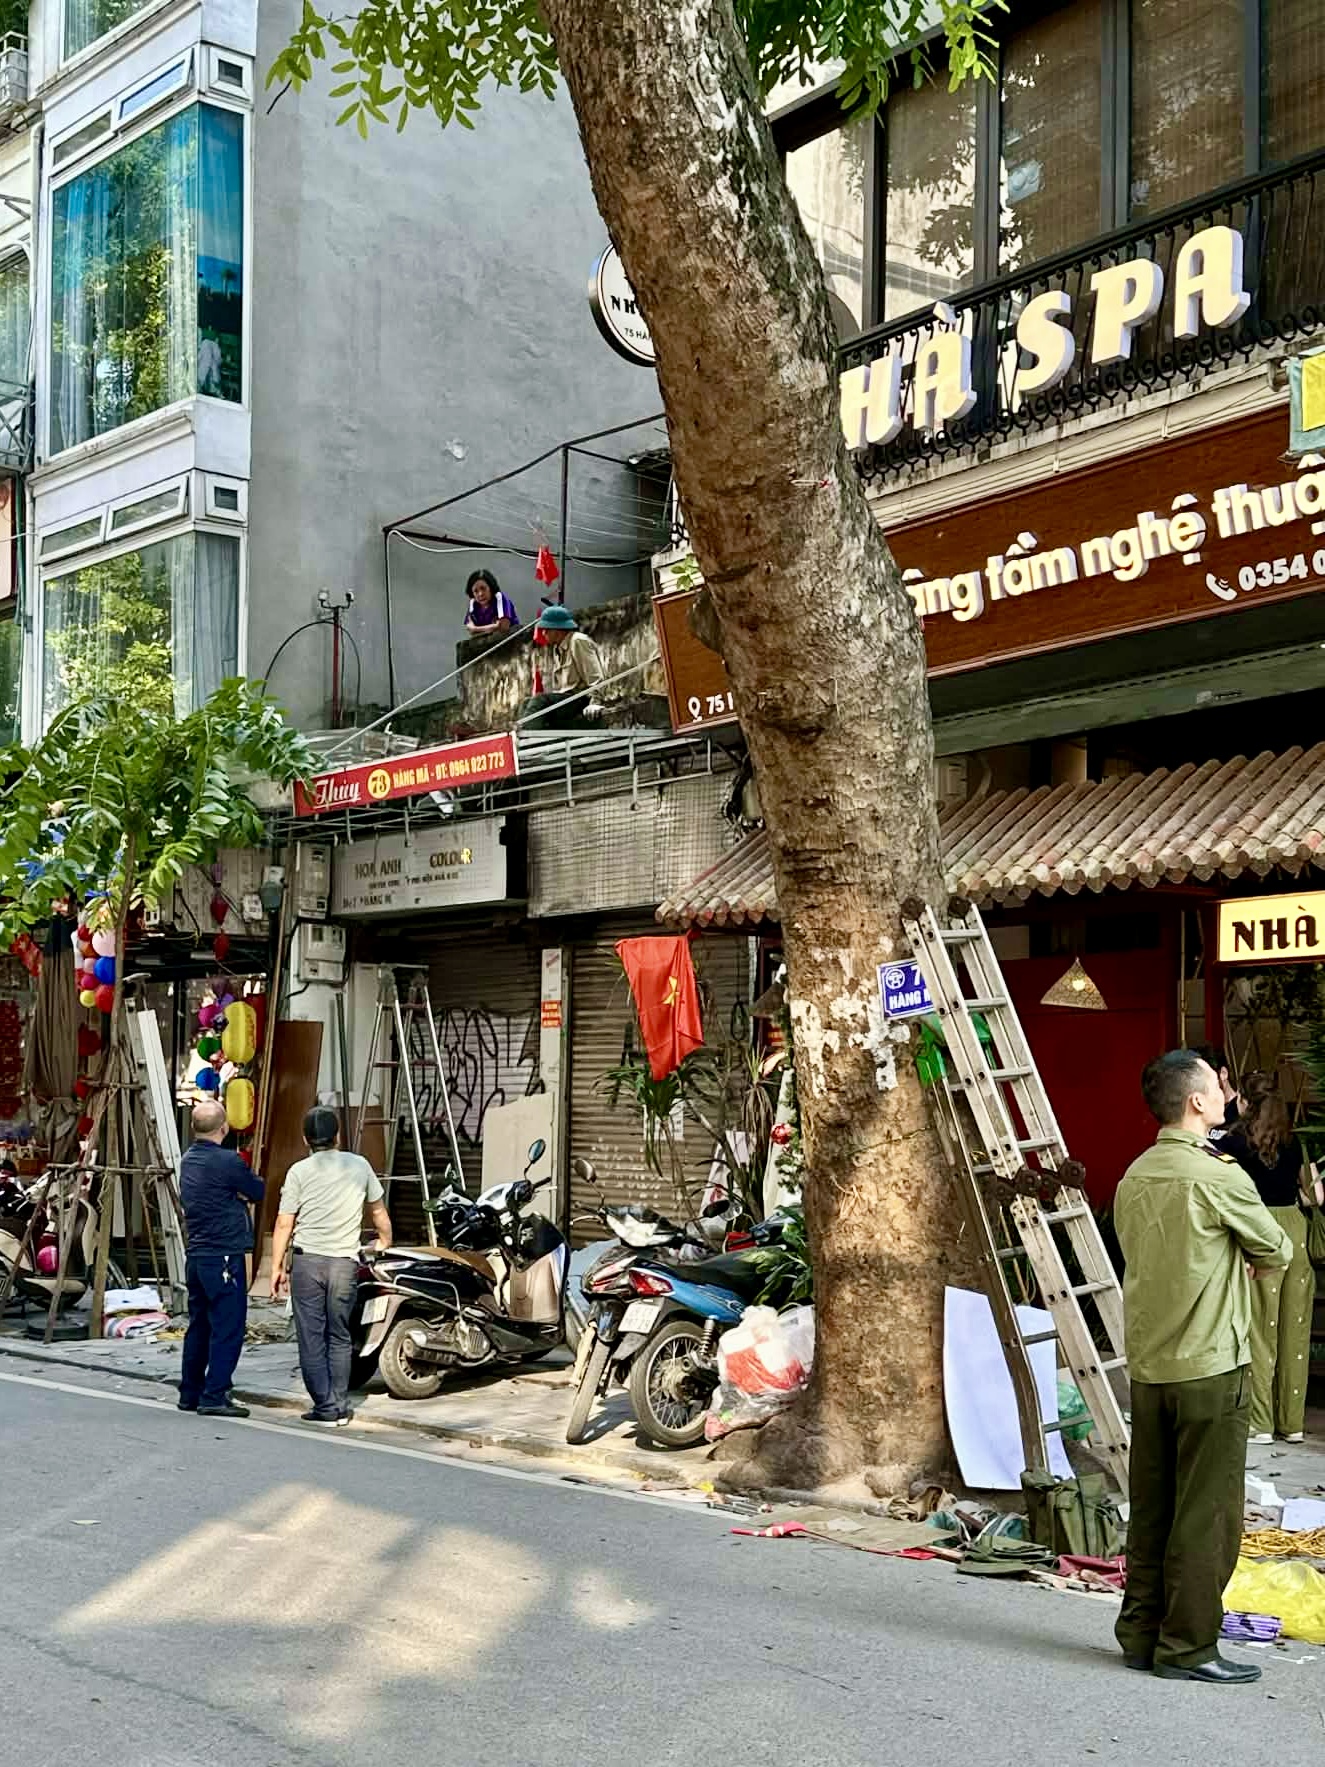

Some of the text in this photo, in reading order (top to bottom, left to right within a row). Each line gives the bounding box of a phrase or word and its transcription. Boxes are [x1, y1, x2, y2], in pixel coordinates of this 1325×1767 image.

[1018, 225, 1251, 393] SPA
[624, 327, 635, 338] 75
[1080, 493, 1206, 581] nghệ
[1238, 553, 1308, 592] 0354
[706, 694, 725, 715] 75
[449, 757, 469, 778] 0964
[470, 753, 487, 774] 023
[488, 751, 505, 770] 773
[1232, 904, 1320, 953] NHÀ
[889, 990, 922, 1010] HÀNG
